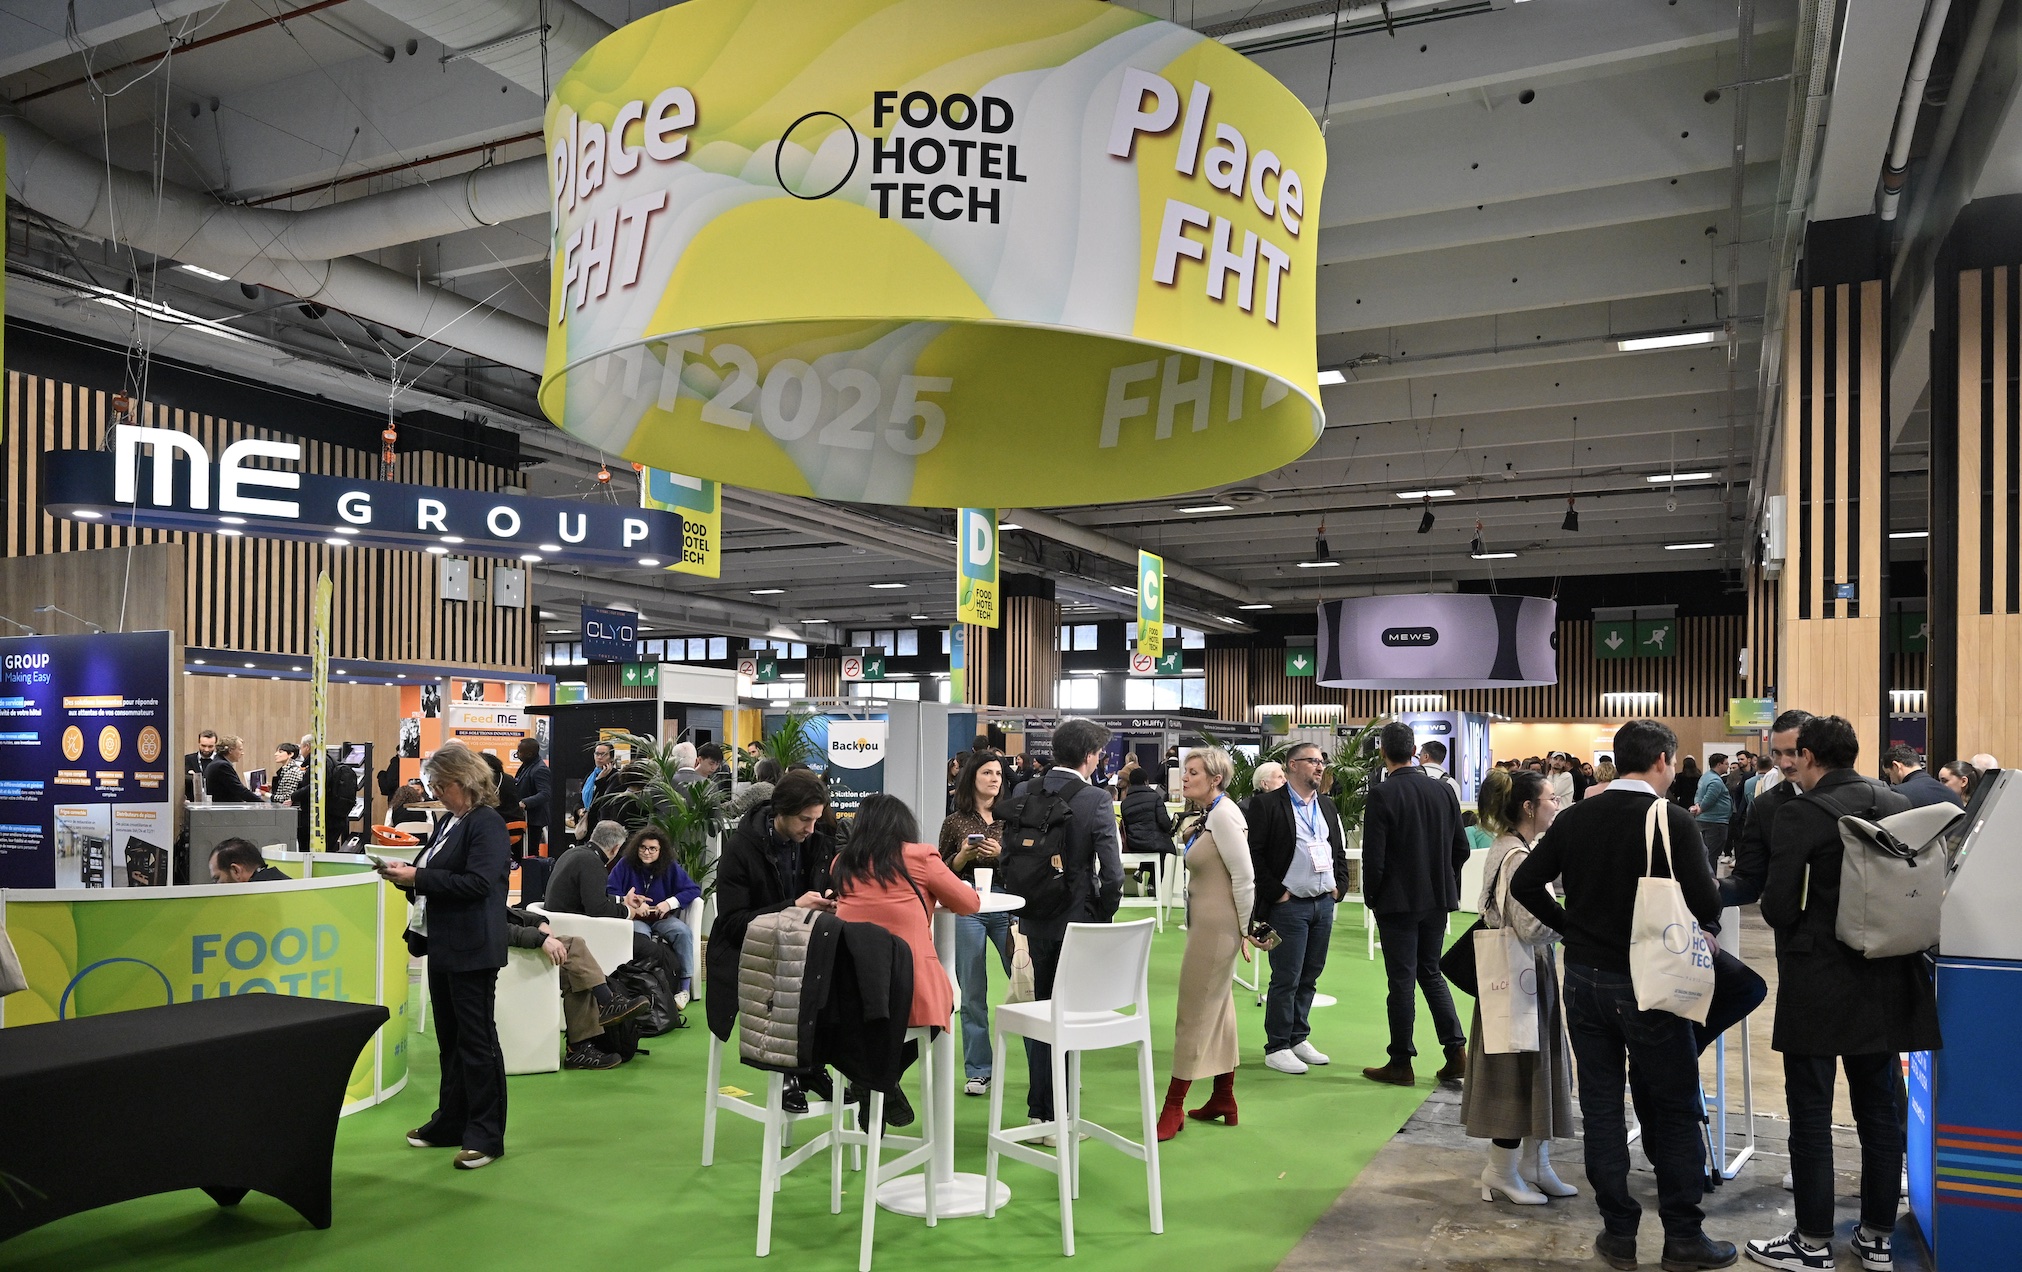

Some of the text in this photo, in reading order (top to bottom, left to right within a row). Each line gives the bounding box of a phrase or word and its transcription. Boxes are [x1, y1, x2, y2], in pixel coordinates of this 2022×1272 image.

[874, 91, 1014, 134] FOOD
[1107, 66, 1304, 235] Place
[554, 86, 696, 235] Place
[873, 137, 1027, 183] HOTEL
[870, 182, 1000, 225] TECH
[559, 189, 666, 324] FHT
[1152, 198, 1290, 324] FHT
[114, 423, 649, 549] ME GROUP
[683, 521, 707, 537] OOD
[683, 535, 710, 552] OTEL
[969, 511, 993, 566] D
[976, 588, 992, 600] FOOD
[1143, 569, 1159, 611] C
[976, 599, 993, 611] HOTEL
[976, 609, 991, 620] TECH
[587, 621, 633, 642] CLYO
[1149, 627, 1158, 636] FOOD
[1389, 633, 1431, 641] MEWS
[5, 653, 50, 670] GROUP
[5, 671, 51, 685] Making Easy
[123, 699, 134, 707] pour
[134, 698, 159, 707] répondre
[114, 709, 154, 717] consommateurs
[832, 741, 879, 753] Backyou
[830, 790, 858, 798] Solution
[830, 800, 837, 808] de
[192, 924, 340, 975] FOOD
